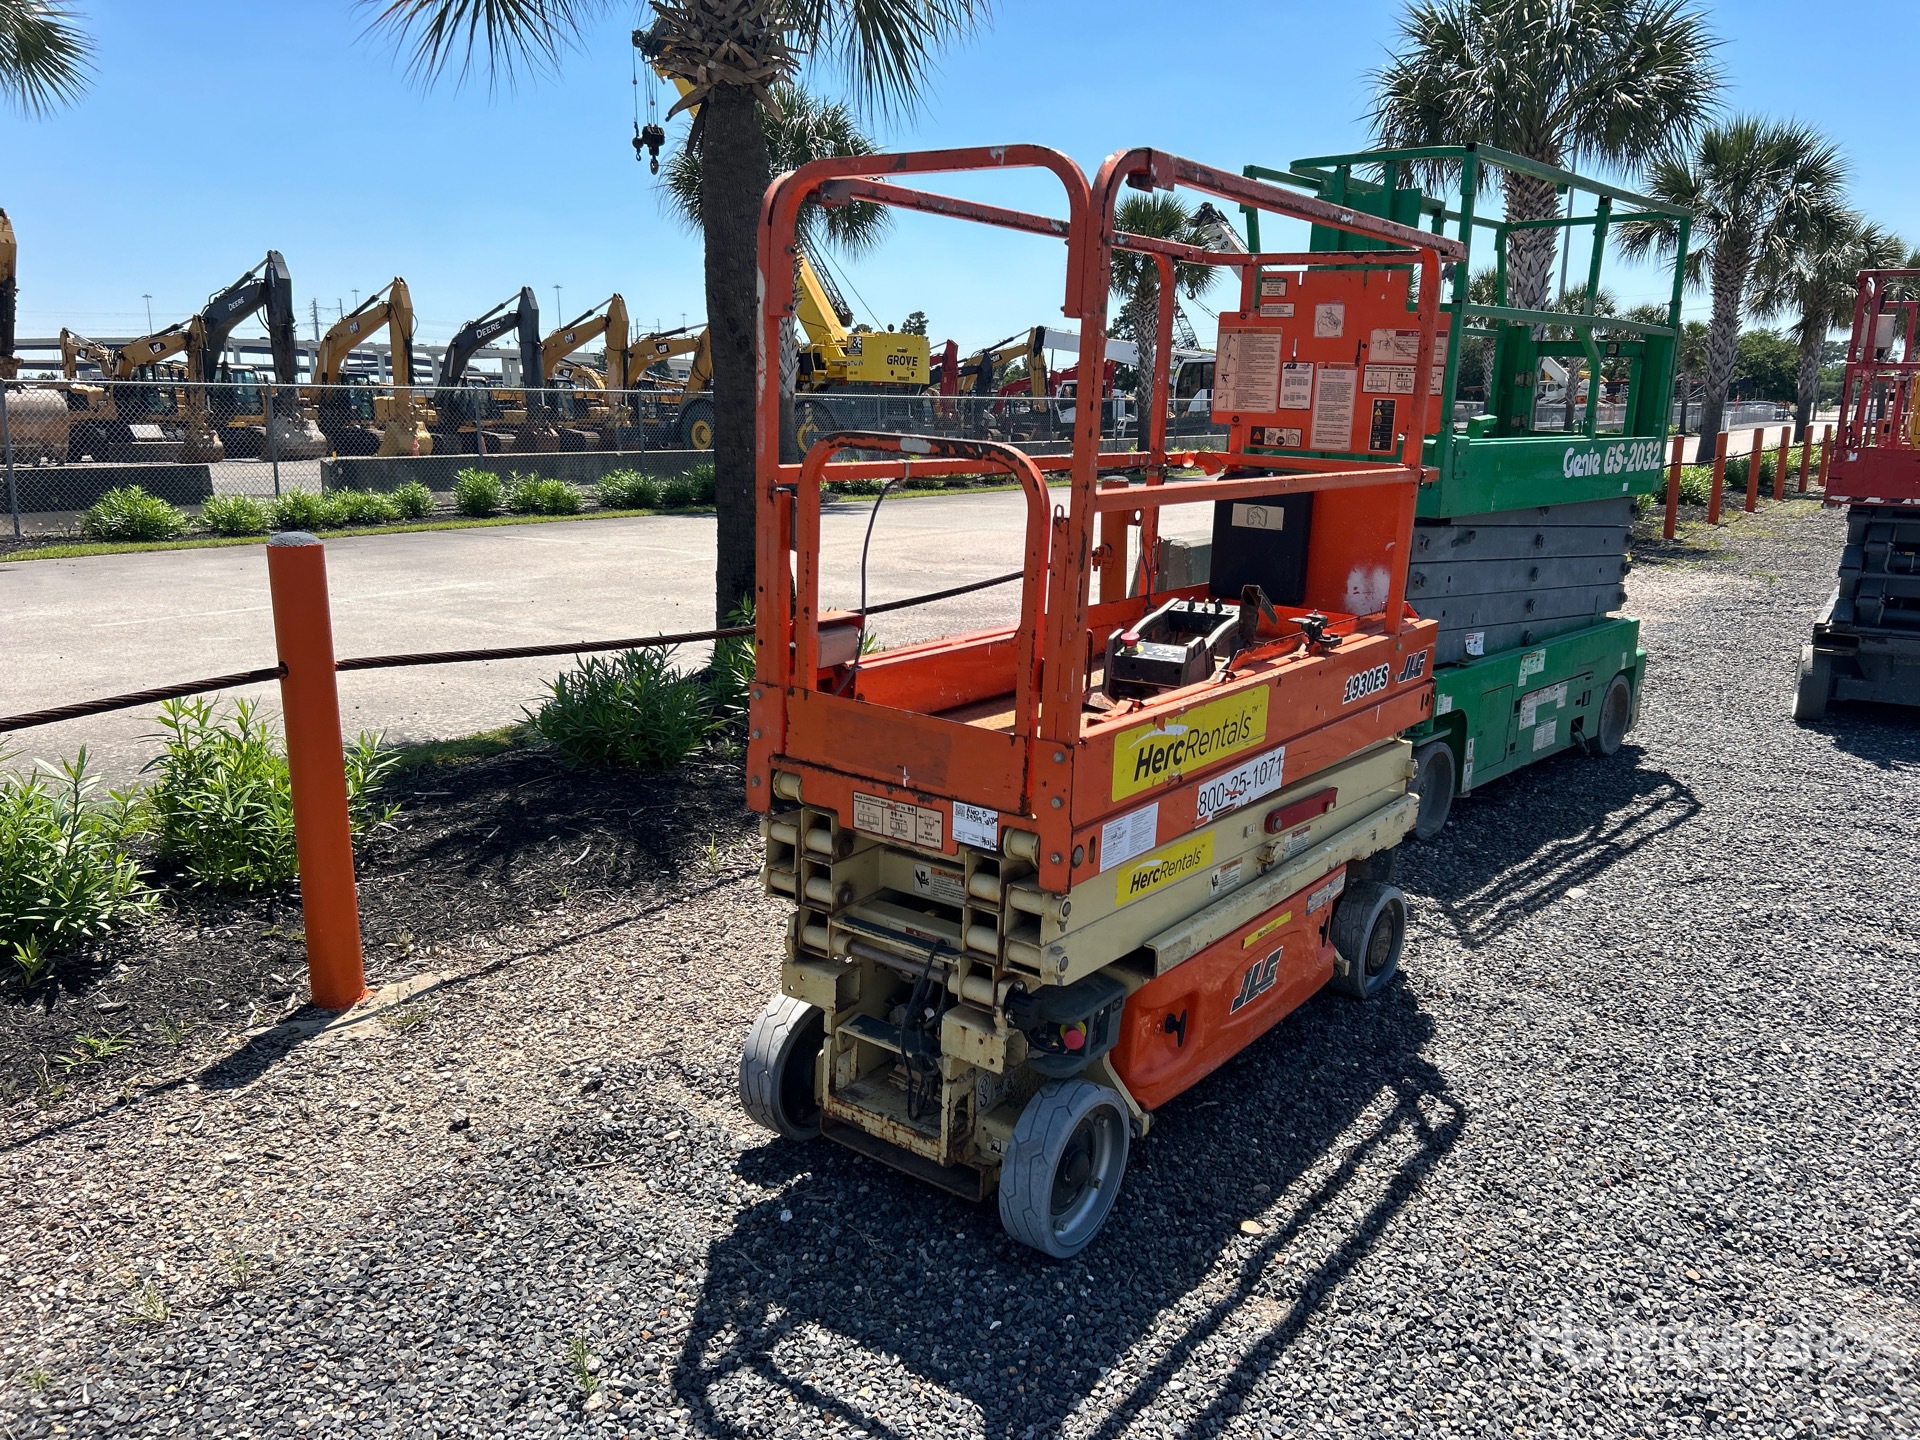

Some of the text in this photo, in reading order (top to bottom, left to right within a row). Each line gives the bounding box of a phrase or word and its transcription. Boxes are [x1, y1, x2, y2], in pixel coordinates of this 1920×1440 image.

[228, 296, 245, 311] DEERE
[476, 320, 501, 339] DEERE
[886, 355, 918, 366] GROVE
[1563, 441, 1661, 478] Genie GS-2032
[1398, 650, 1427, 683] JLG
[1343, 663, 1390, 704] 1930ES
[863, 796, 880, 804] CAPACITY
[1198, 753, 1283, 817] 800-25-1071
[1229, 944, 1284, 1016] JLG
